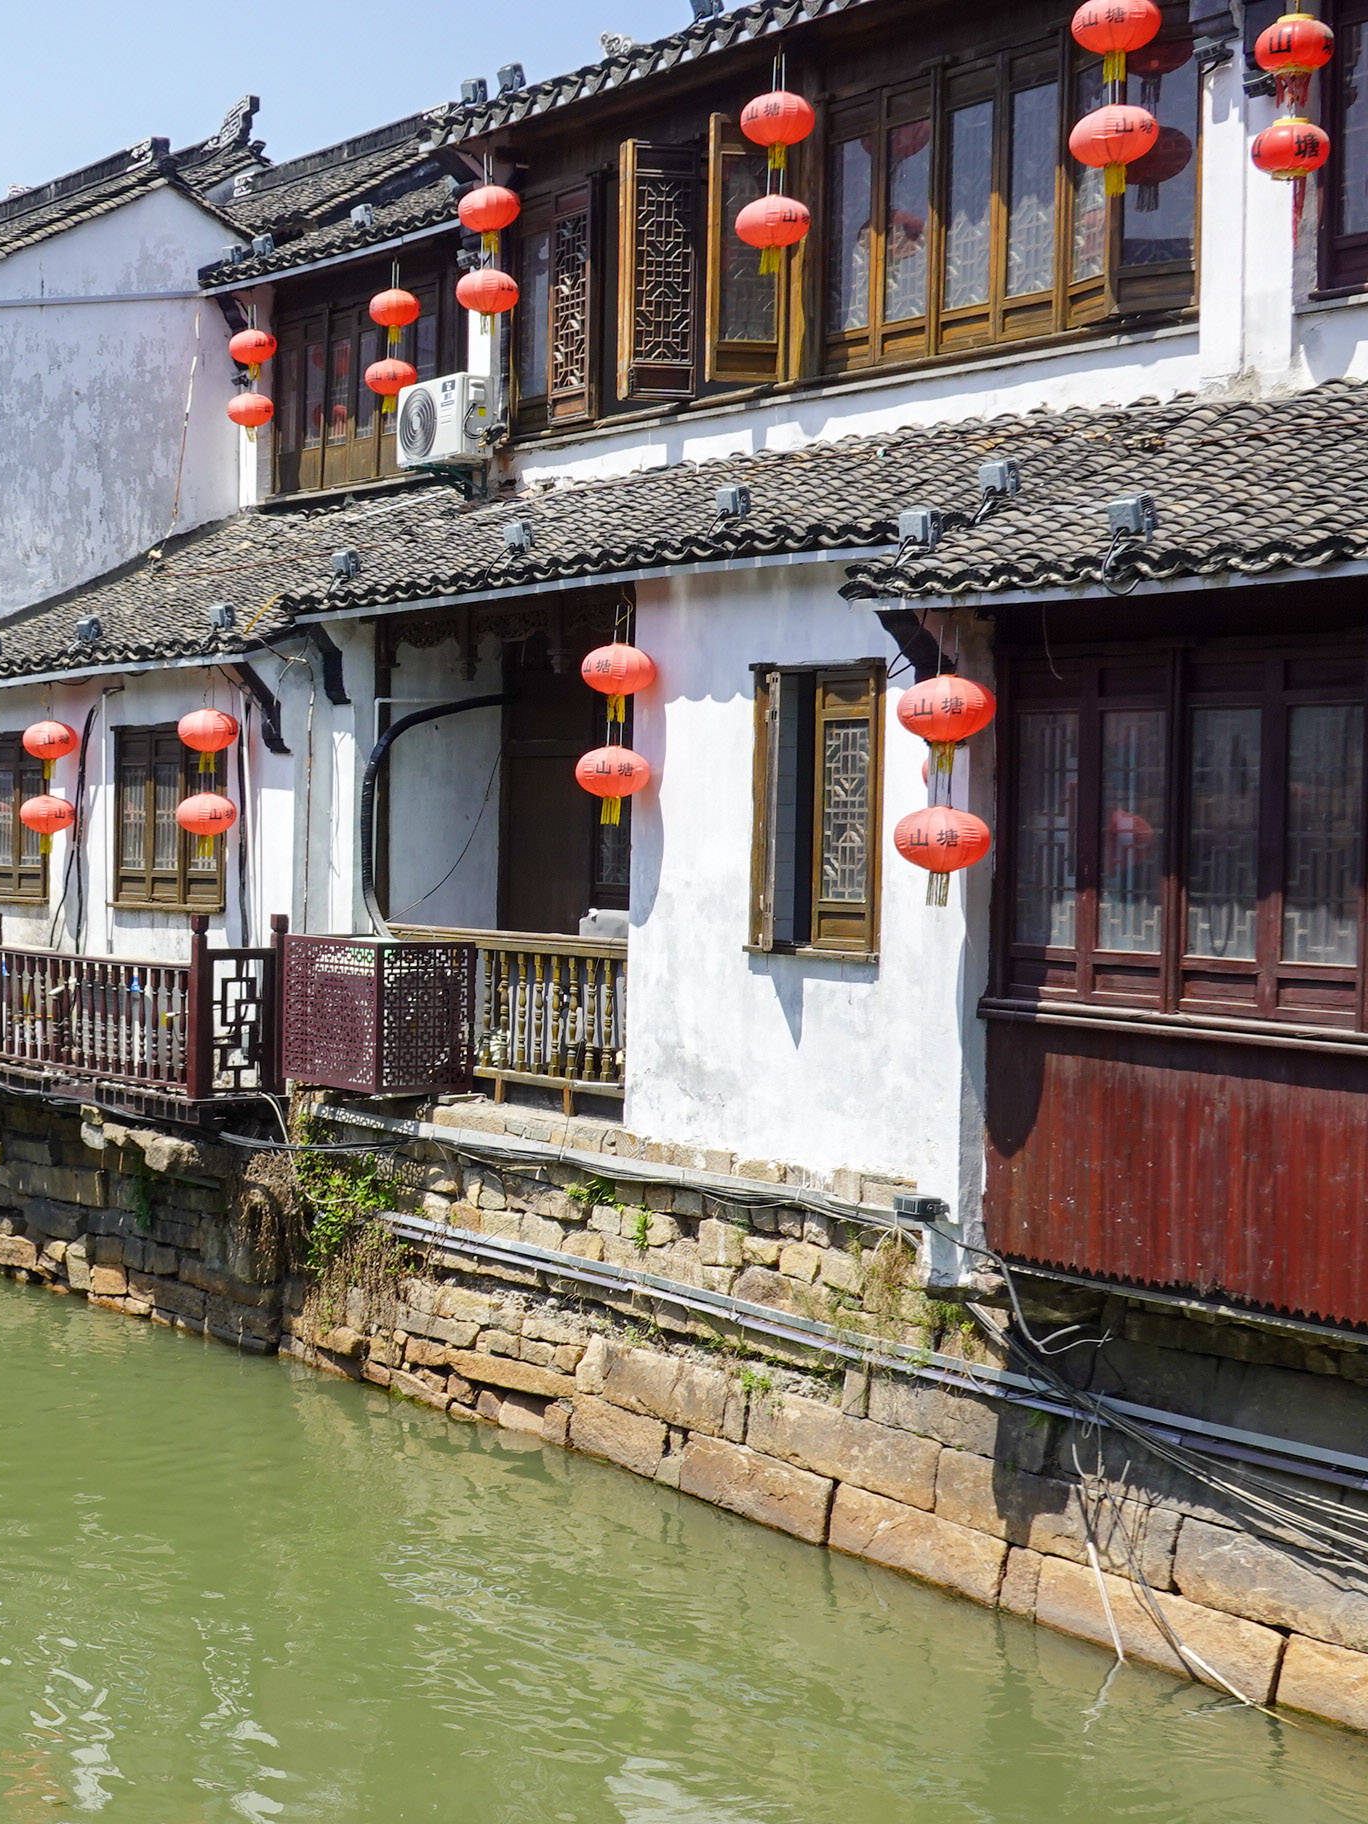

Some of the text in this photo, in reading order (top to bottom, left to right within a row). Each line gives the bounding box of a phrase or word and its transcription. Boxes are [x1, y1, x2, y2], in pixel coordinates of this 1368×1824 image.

[1082, 6, 1126, 28] 山塘
[746, 102, 781, 121] 山塘
[1115, 116, 1154, 134] 山塘
[583, 659, 612, 673] 山塘
[913, 695, 965, 716] 山塘
[595, 760, 634, 777] 山塘
[909, 828, 961, 847] 山塘
